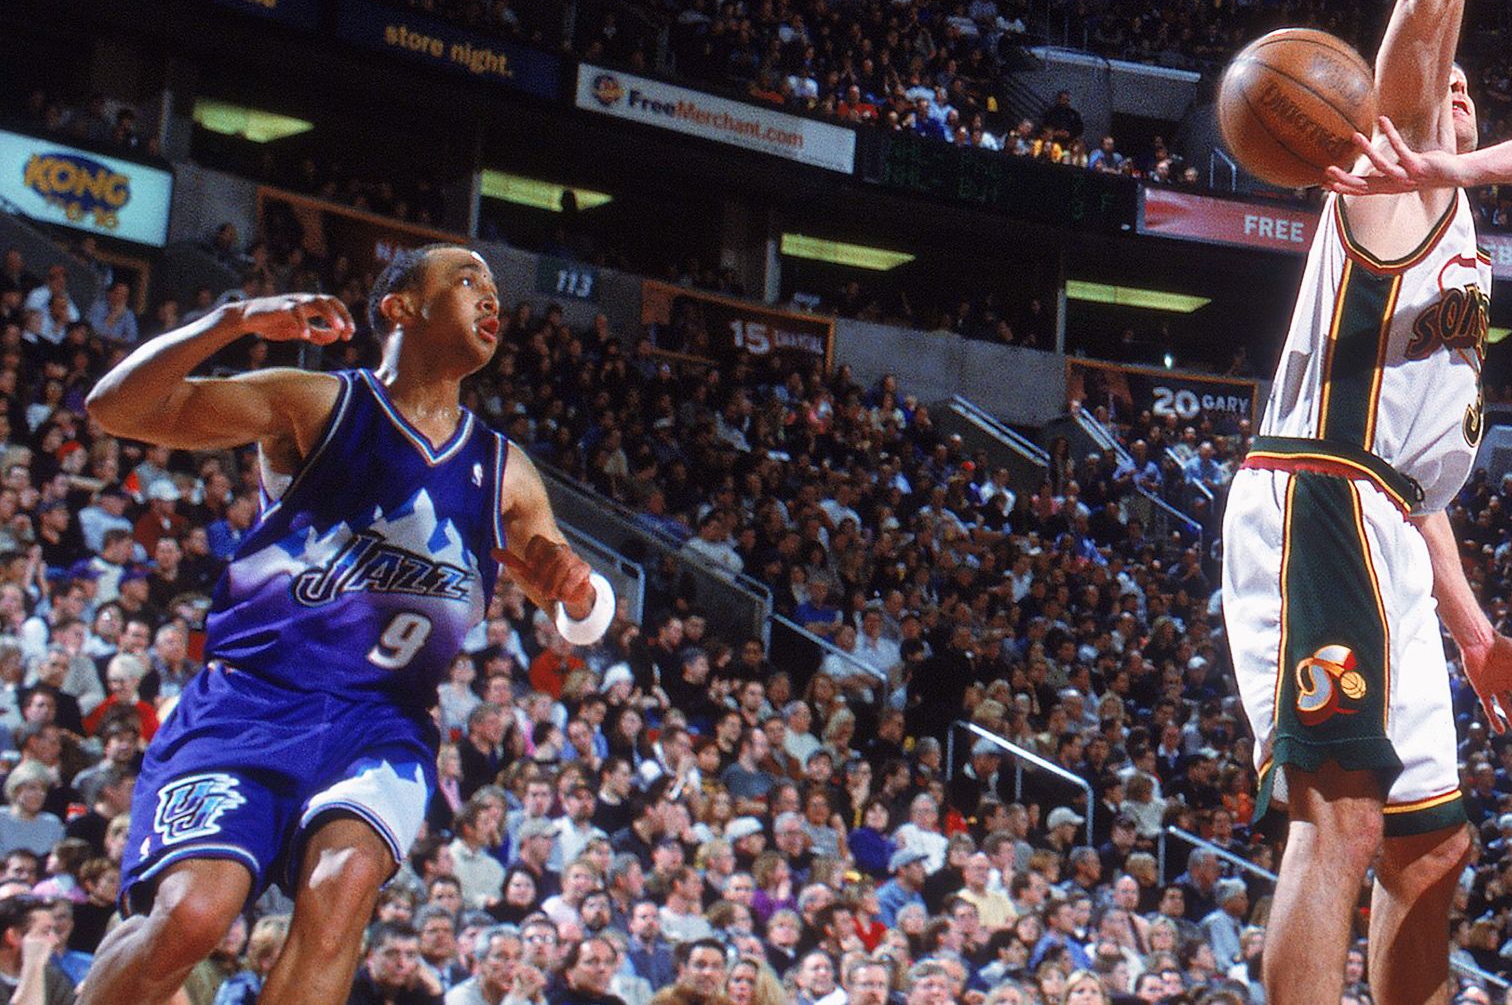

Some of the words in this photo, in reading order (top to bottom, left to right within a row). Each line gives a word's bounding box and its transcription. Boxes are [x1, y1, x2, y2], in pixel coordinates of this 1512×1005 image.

[384, 24, 444, 58] store
[450, 42, 513, 79] night.
[628, 89, 803, 148] FreeMerchant.com
[24, 154, 130, 207] KONG
[1243, 214, 1305, 243] FREE
[730, 320, 771, 354] 15
[1404, 282, 1490, 360] SON
[1152, 387, 1200, 419] 20
[1202, 394, 1249, 414] GARY
[368, 613, 431, 669] 9
